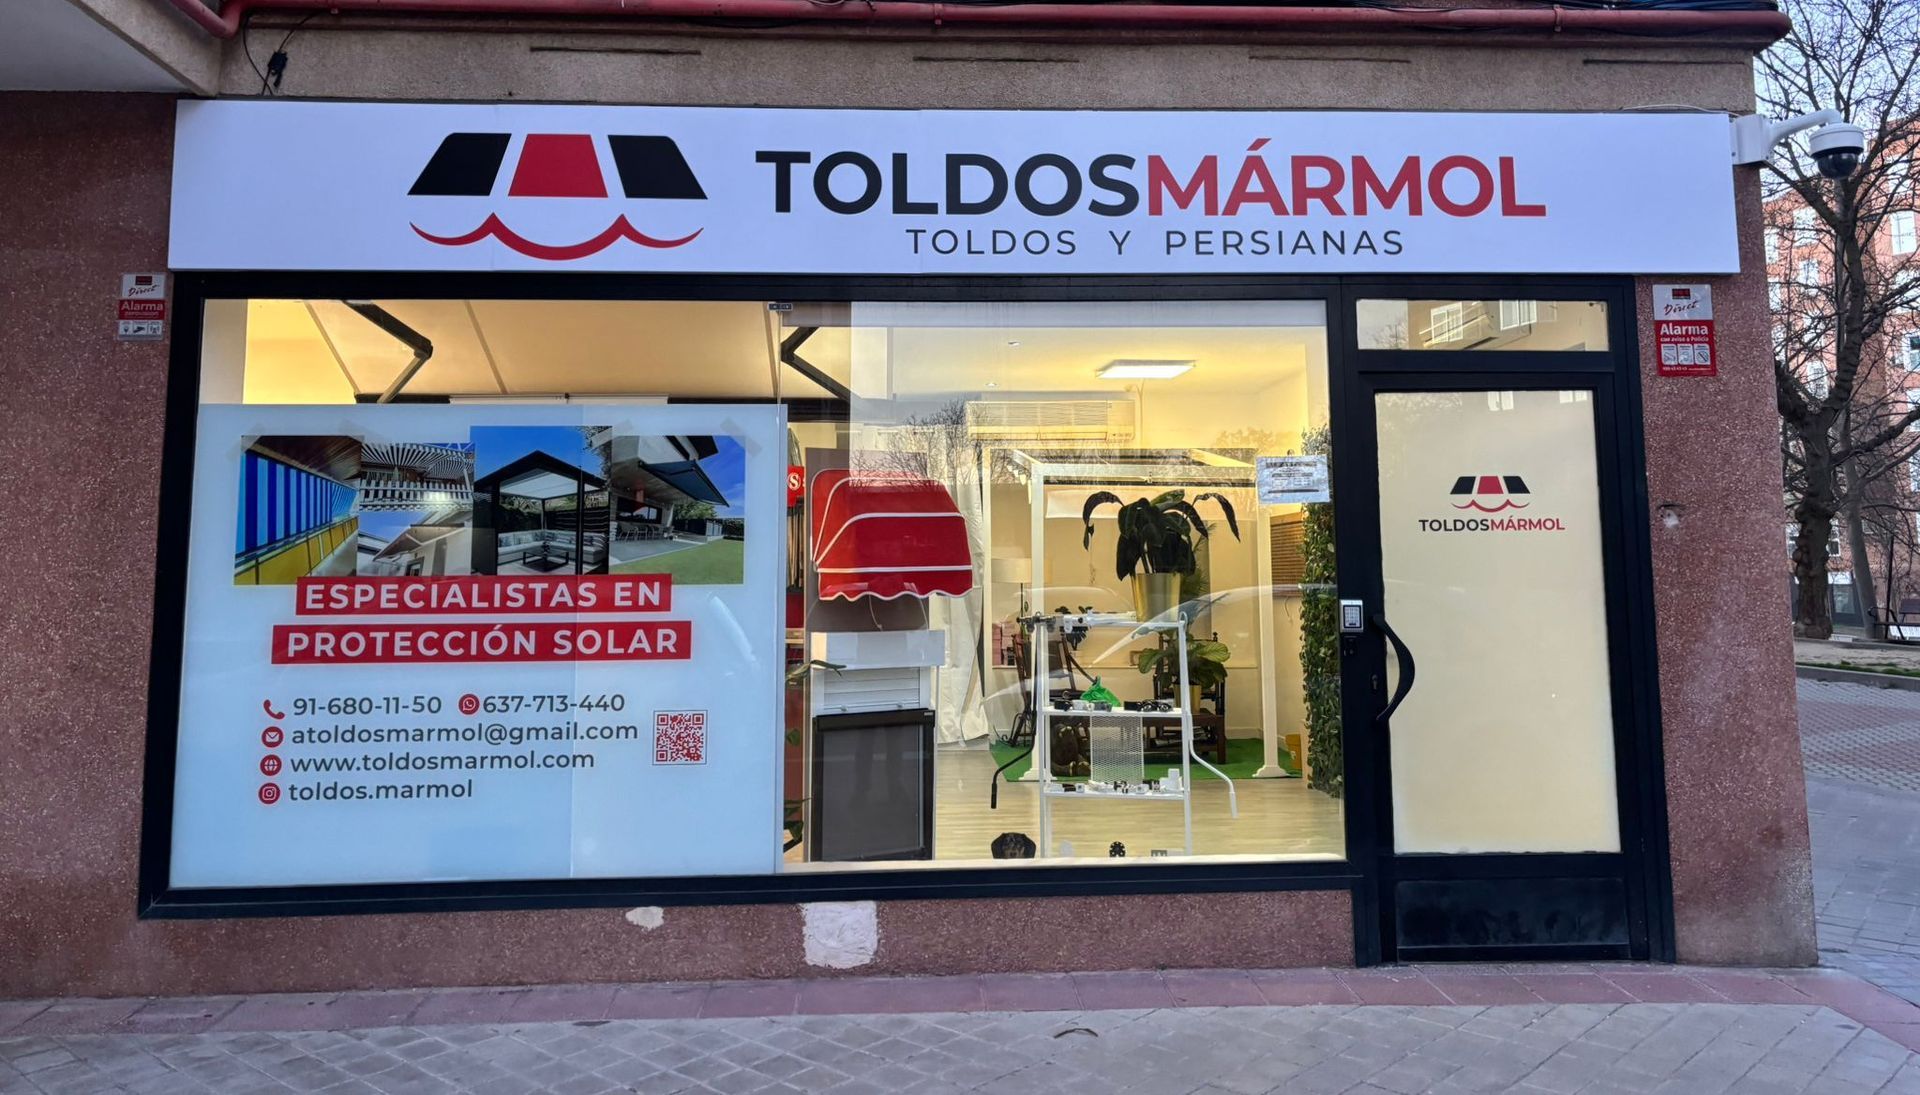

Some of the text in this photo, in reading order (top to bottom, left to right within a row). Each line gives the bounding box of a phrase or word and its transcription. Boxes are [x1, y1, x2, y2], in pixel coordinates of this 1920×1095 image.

[755, 138, 1547, 217] TOLDOSMÁRMOL
[905, 229, 1404, 255] TOLDOS Y PERSIANAS
[128, 284, 160, 297] Direct
[120, 301, 164, 311] Alarma
[1663, 299, 1700, 316] Direct
[1660, 322, 1709, 335] Alarma
[1418, 515, 1566, 532] TOLDOSMÁRMOL
[304, 581, 661, 609] ESPECIALISTAS EN
[287, 624, 678, 658] PROTECCIÓN SOLAR
[293, 694, 626, 716] 91-680-11-50 637-713-440
[291, 722, 639, 746] atoldosmarmol@gmail.com
[290, 750, 596, 773] www.toldosmarmol.com
[288, 779, 473, 802] toldos.marmol
